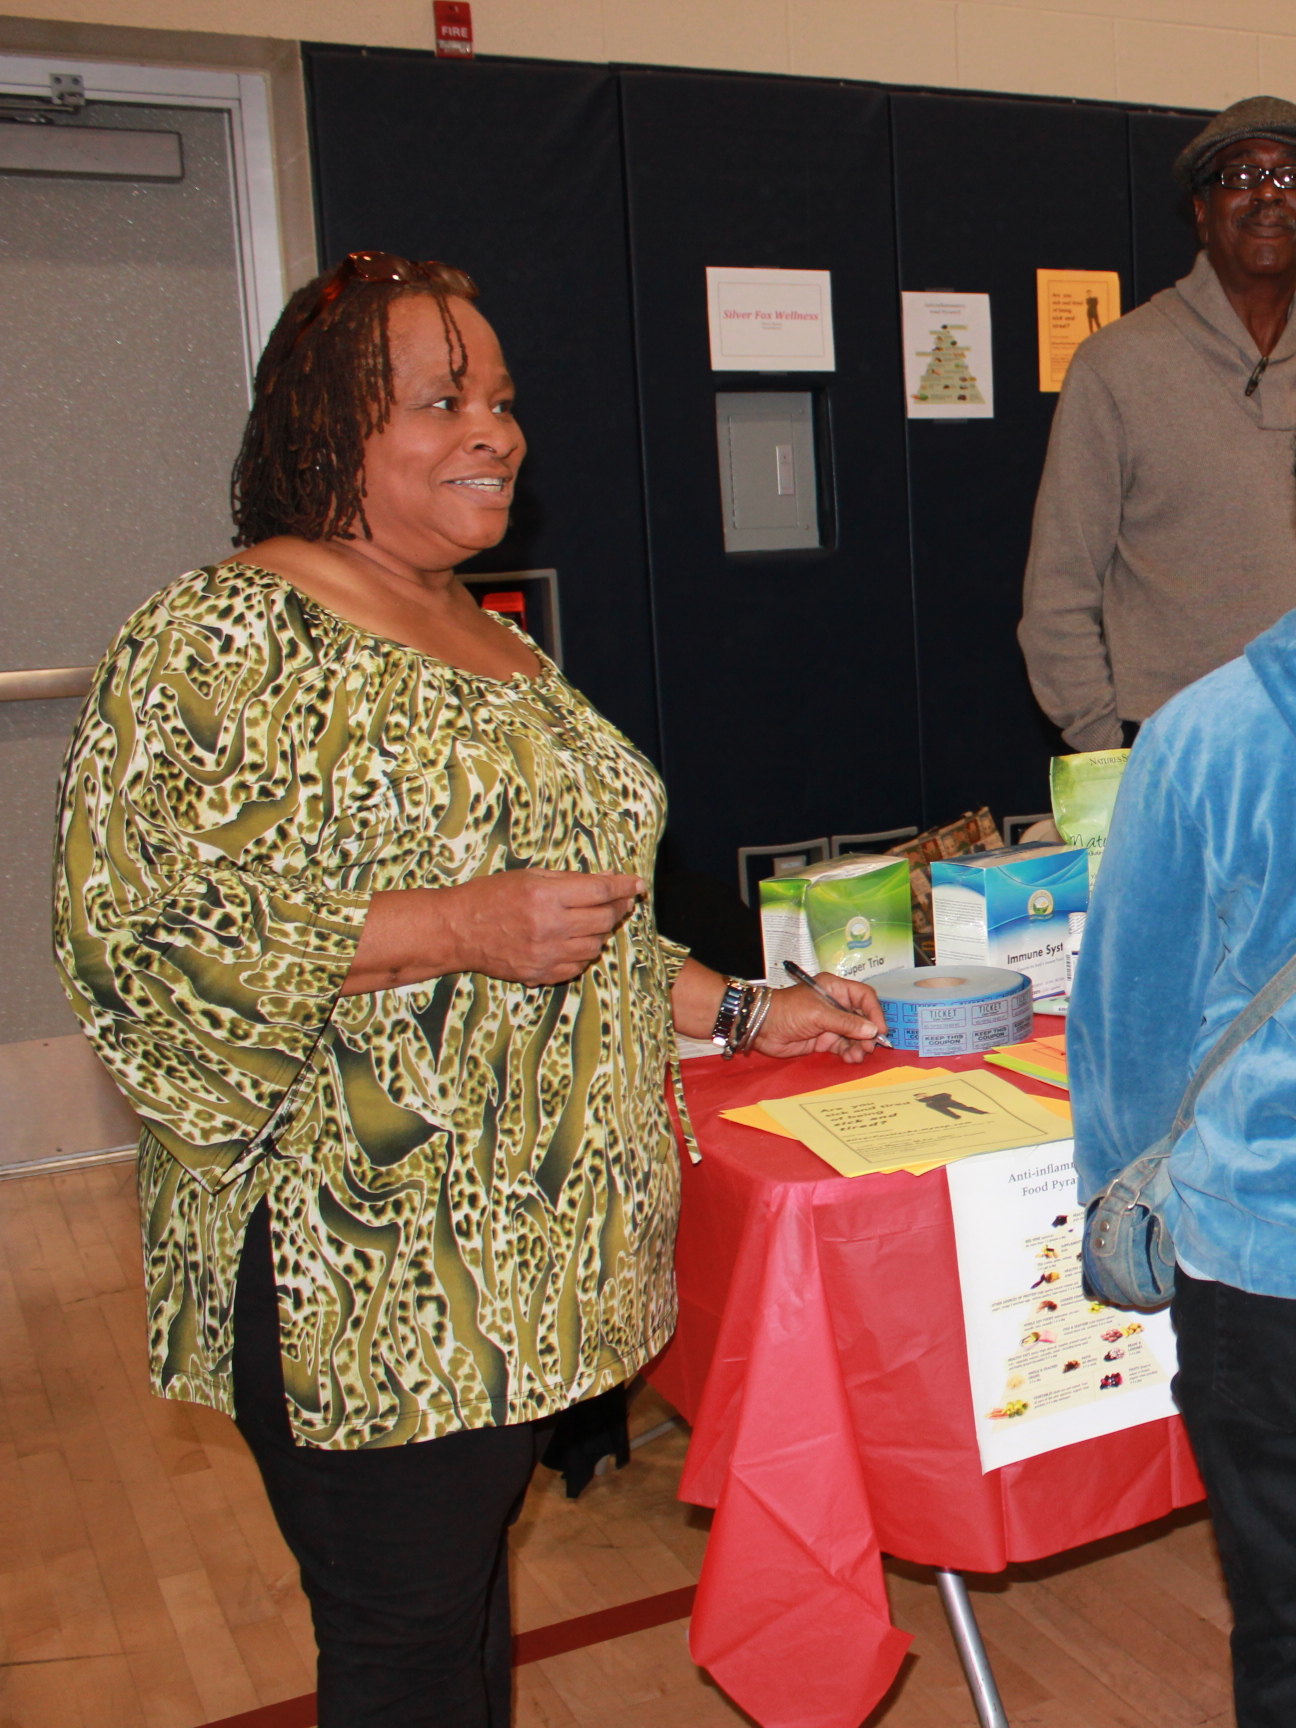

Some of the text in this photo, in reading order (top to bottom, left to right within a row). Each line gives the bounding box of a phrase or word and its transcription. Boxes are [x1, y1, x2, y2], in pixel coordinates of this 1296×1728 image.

[441, 25, 468, 38] FIRE
[723, 309, 819, 321] Silver Fox Wellness
[1007, 942, 1064, 965] Immune Syst
[843, 962, 866, 977] Super
[868, 956, 885, 968] Trio
[930, 1009, 957, 1018] TICKET
[979, 1003, 1002, 1013] TICKET
[977, 1032, 1005, 1041] COUPON
[847, 1110, 884, 1119] being
[870, 1112, 898, 1121] and
[840, 1120, 888, 1131] tired?
[1022, 1177, 1077, 1196] Food Pyra
